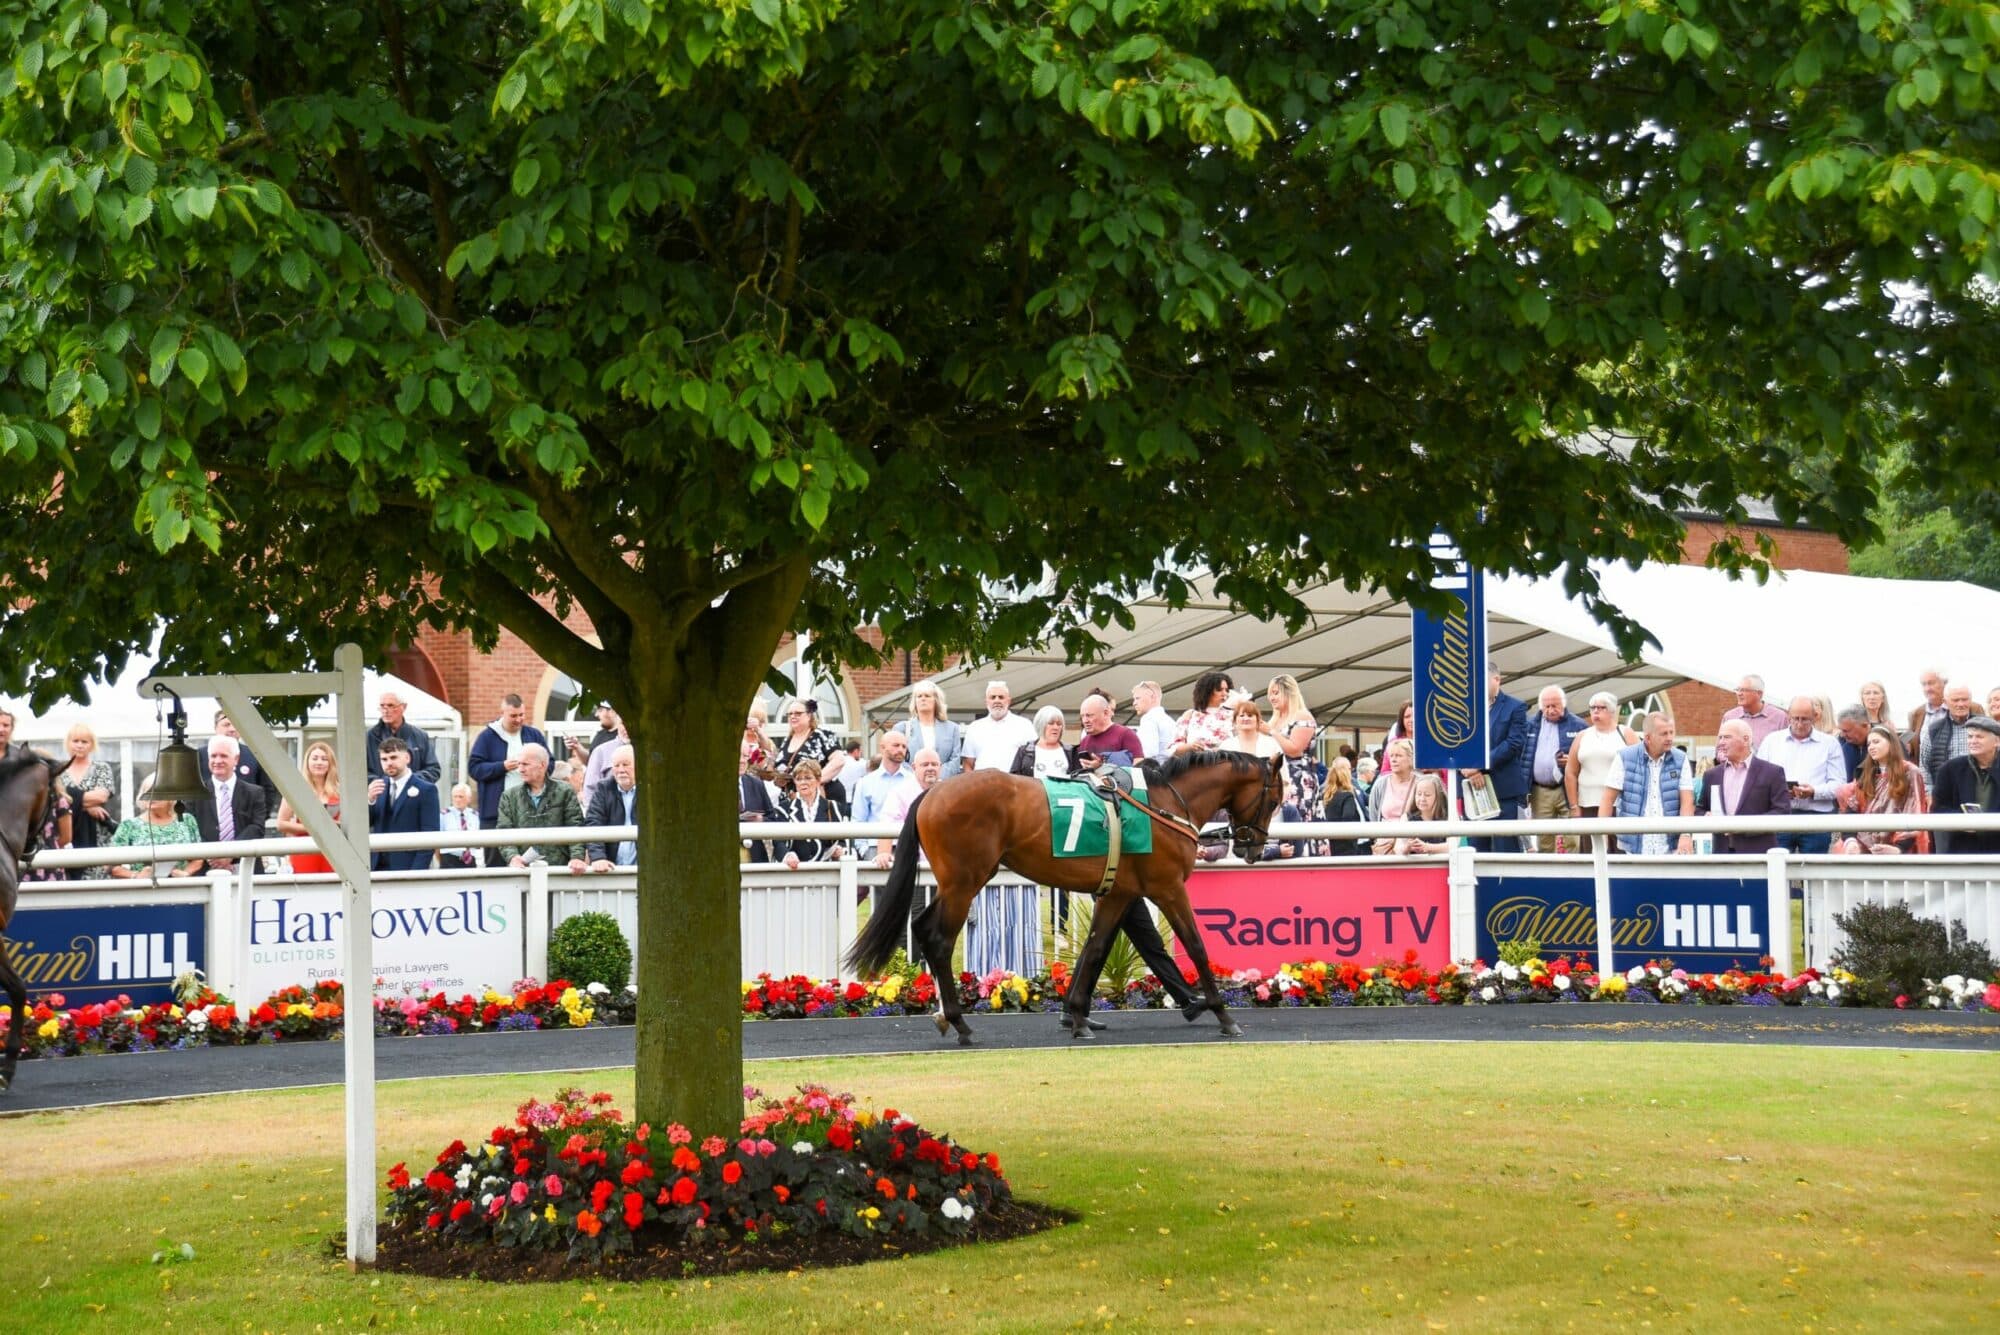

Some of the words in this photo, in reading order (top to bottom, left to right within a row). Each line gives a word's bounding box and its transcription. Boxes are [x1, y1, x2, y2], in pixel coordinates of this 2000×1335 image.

[1057, 798, 1085, 852] 7
[249, 889, 507, 945] Harowells
[1193, 906, 1362, 957] Racing
[1373, 906, 1438, 944] TV
[1486, 896, 1660, 946] Willim
[1663, 904, 1761, 948] HILL
[98, 932, 196, 980] HILL
[252, 948, 336, 963] OLICITORS
[307, 967, 337, 978] Rural
[372, 965, 401, 976] quine
[405, 961, 449, 974] Lawyers
